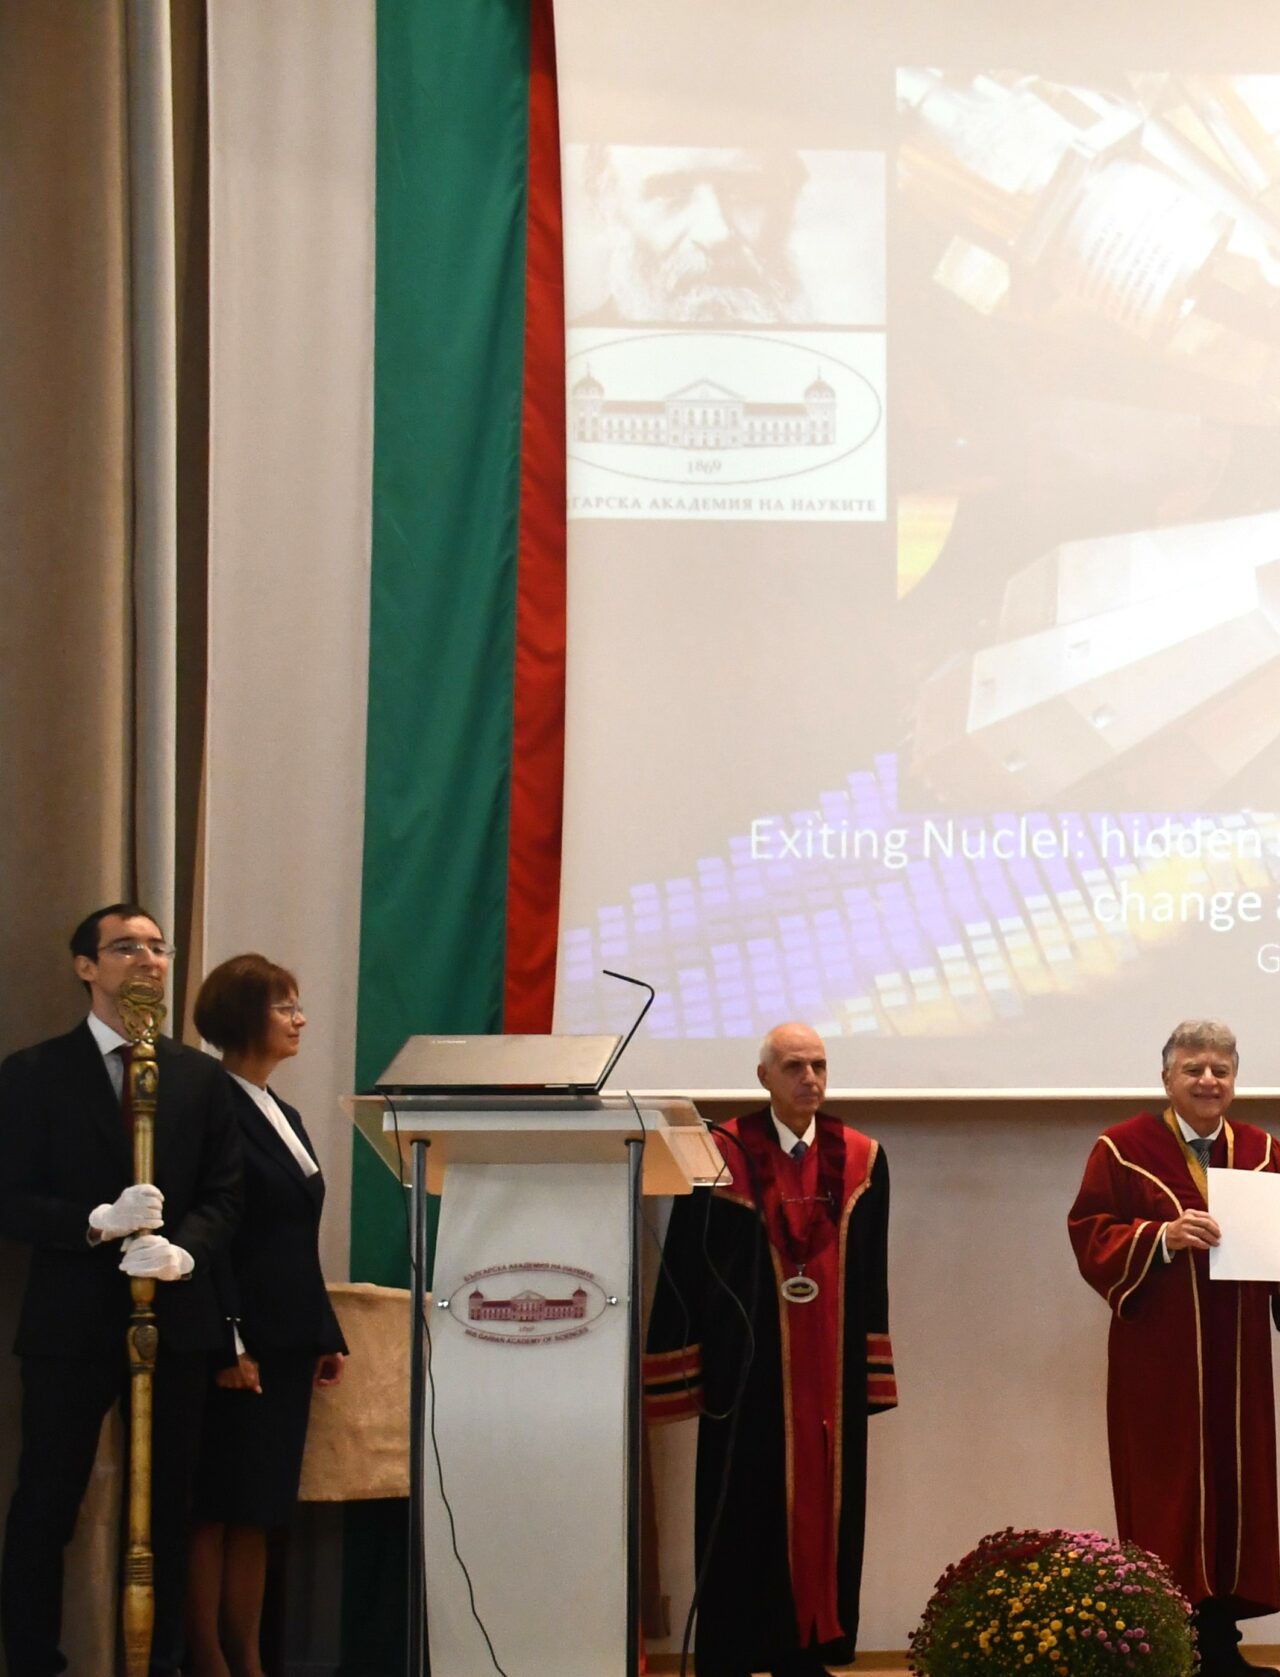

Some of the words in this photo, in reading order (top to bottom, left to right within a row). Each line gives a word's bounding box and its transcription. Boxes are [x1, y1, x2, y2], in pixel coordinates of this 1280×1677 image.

[688, 459, 722, 474] 1869
[649, 496, 752, 513] АКАДЕМИЯ
[759, 497, 785, 512] НА
[791, 497, 876, 513] НАУКИТЕ
[750, 818, 908, 870] Exiting
[923, 816, 1086, 860] Nuclei:
[1101, 816, 1263, 859] hidden
[1093, 880, 1263, 932] change
